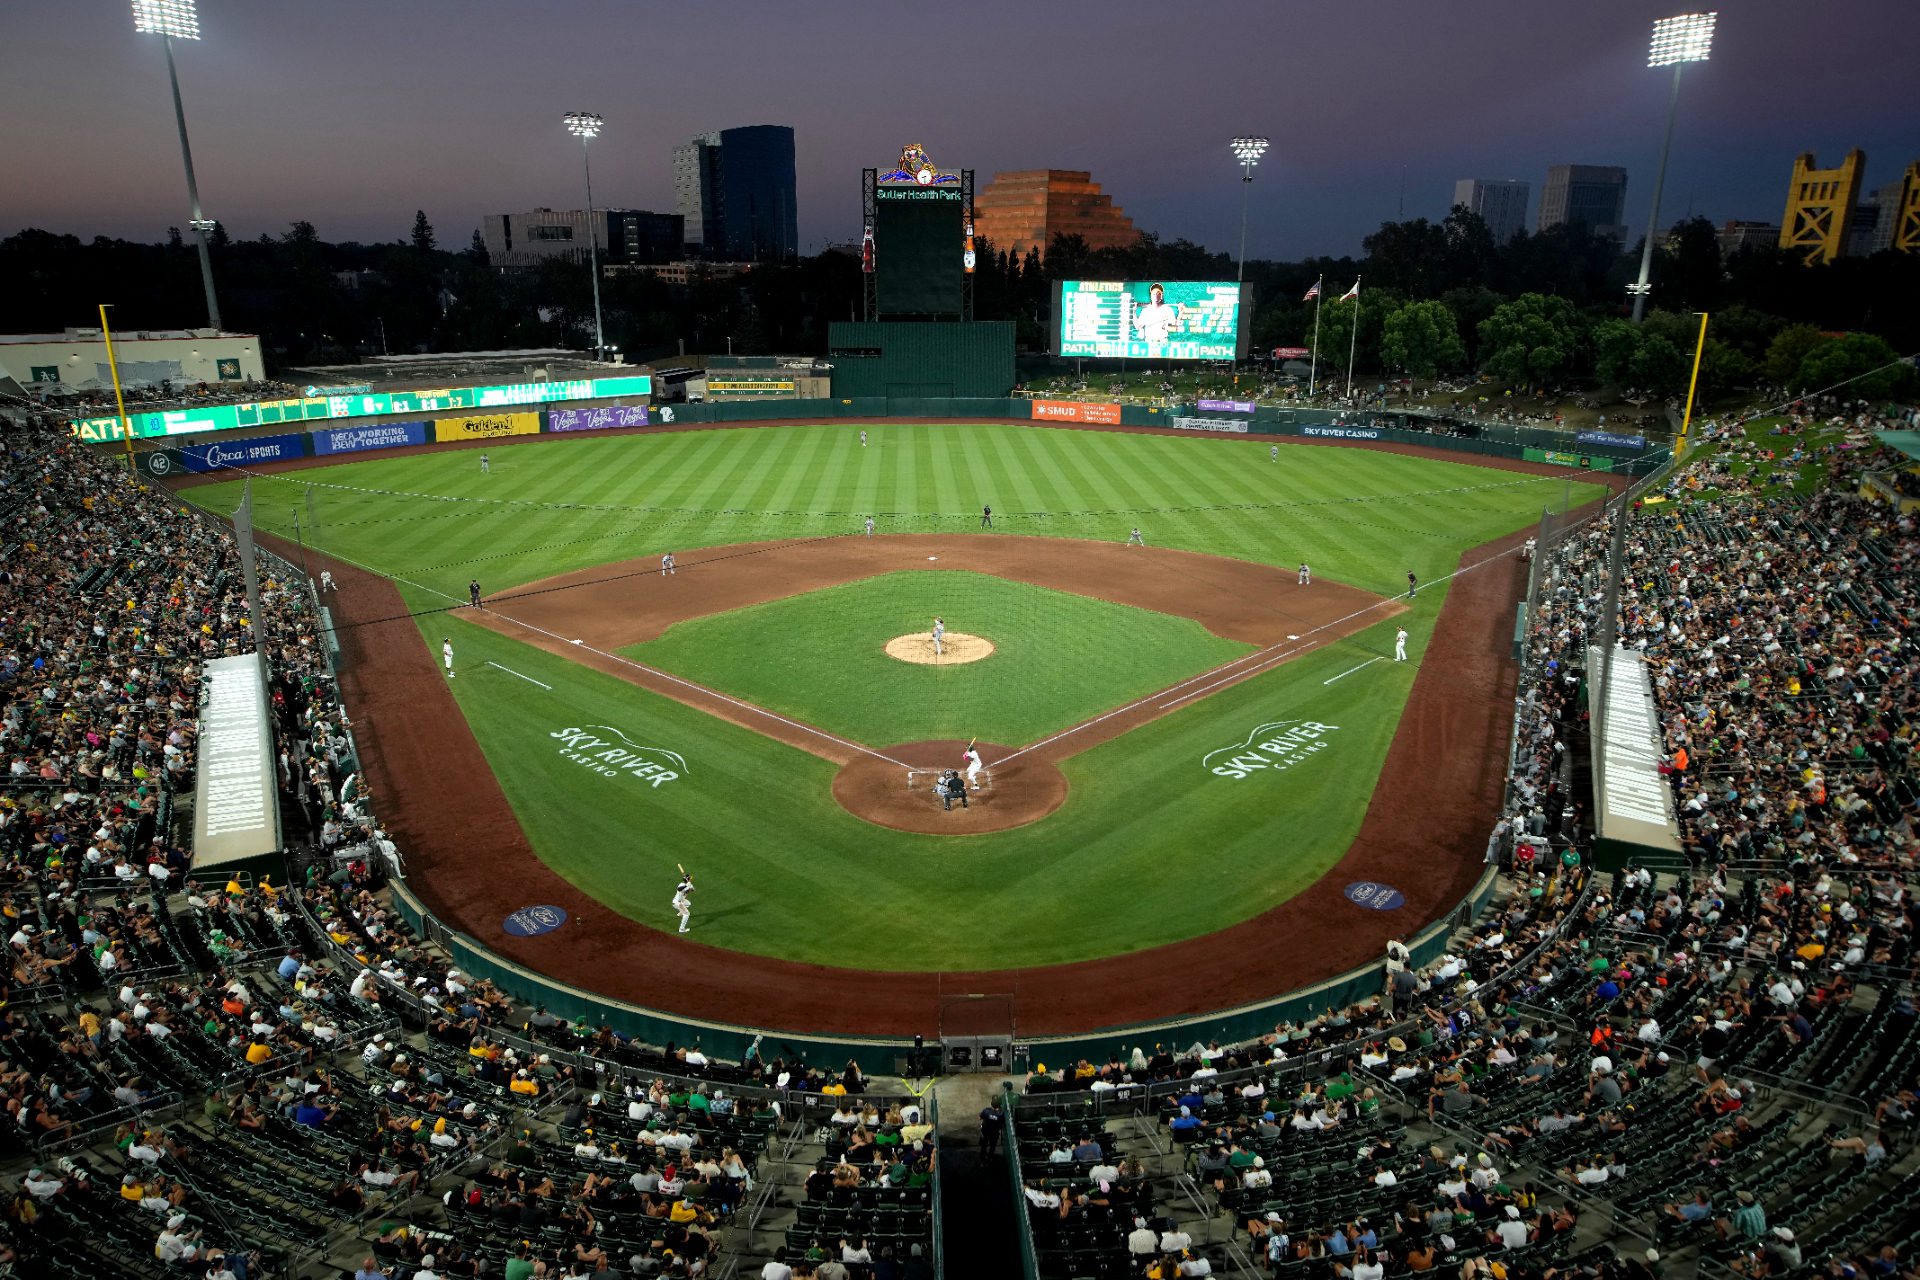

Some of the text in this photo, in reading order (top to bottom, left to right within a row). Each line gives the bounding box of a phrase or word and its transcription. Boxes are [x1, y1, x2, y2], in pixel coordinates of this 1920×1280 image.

[877, 189, 962, 200] Sutter Health Park
[1079, 281, 1124, 292] ATHLETICS
[583, 409, 614, 428] Vegas
[615, 407, 648, 426] Vegas
[1047, 406, 1077, 416] SMUD
[550, 412, 582, 431] Vegas
[358, 427, 405, 439] WORKING
[359, 434, 409, 447] TOGETHER
[1304, 427, 1378, 439] SKY RIVER CASINO
[152, 457, 166, 470] 42
[207, 444, 281, 468] Circa SPORTS
[550, 727, 679, 788] SKY RIVER
[1212, 721, 1340, 779] SKY RIVER
[1273, 741, 1328, 770] CASINO
[559, 748, 618, 777] CASINO
[1604, 760, 1668, 827] WELCOME
[206, 775, 265, 837] BASEBALL
